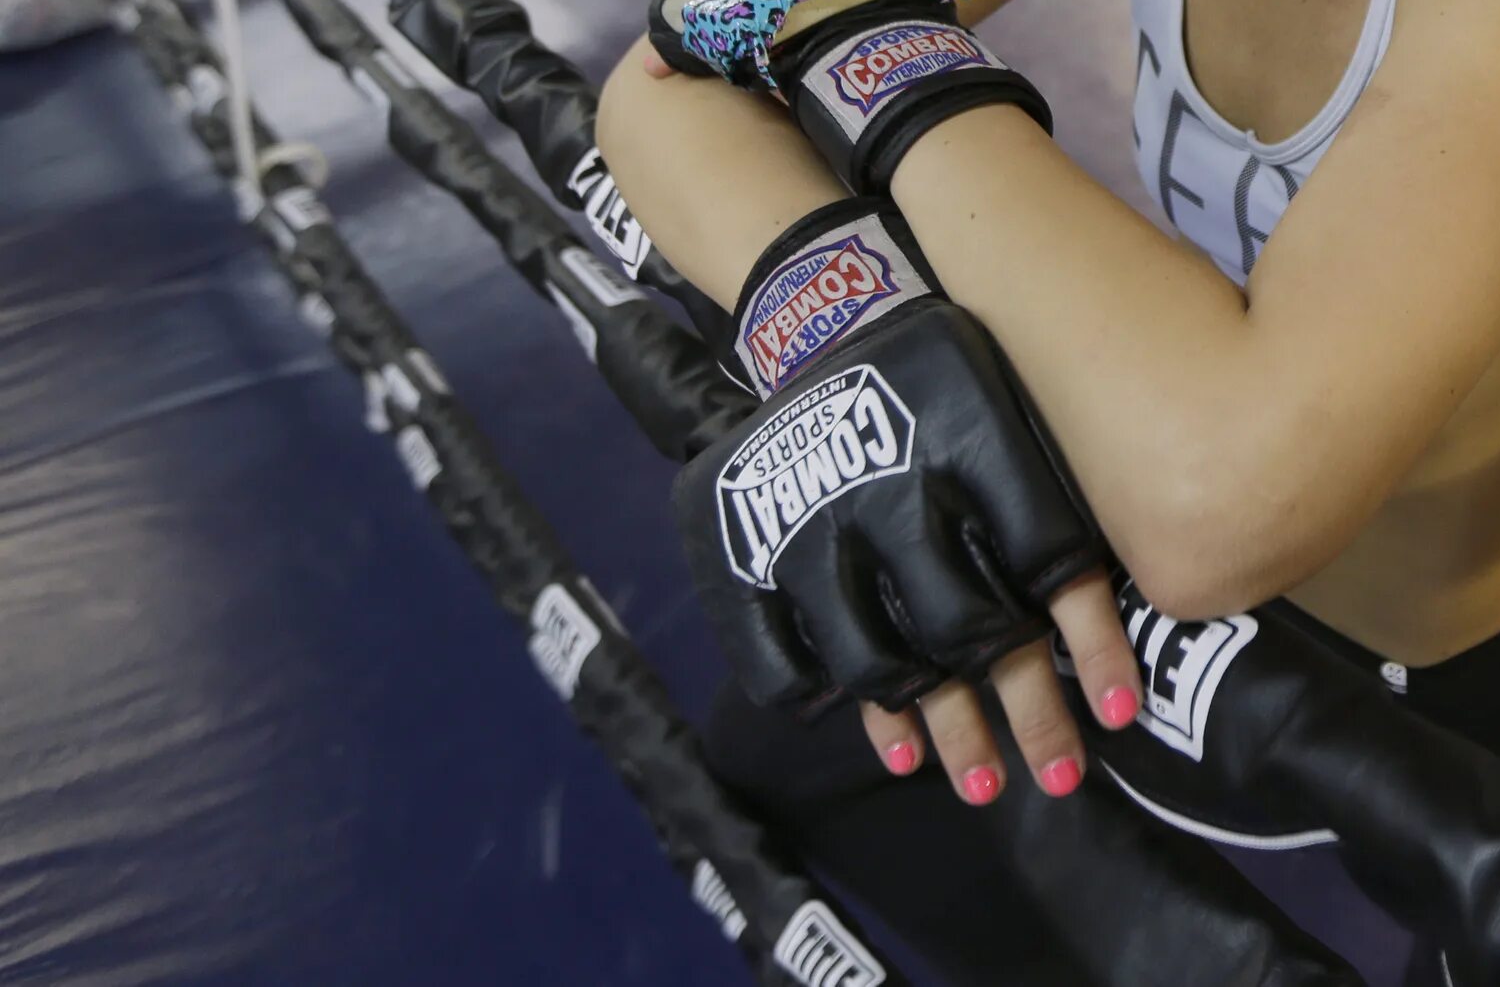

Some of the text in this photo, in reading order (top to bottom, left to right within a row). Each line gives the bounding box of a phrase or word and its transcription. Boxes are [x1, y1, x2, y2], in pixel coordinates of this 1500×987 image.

[845, 32, 977, 96] COMBAT
[751, 251, 876, 381] COMBAT
[734, 377, 847, 467] INTERNATIONAL
[754, 404, 836, 478] SPORTS
[732, 386, 898, 572] COMBAT
